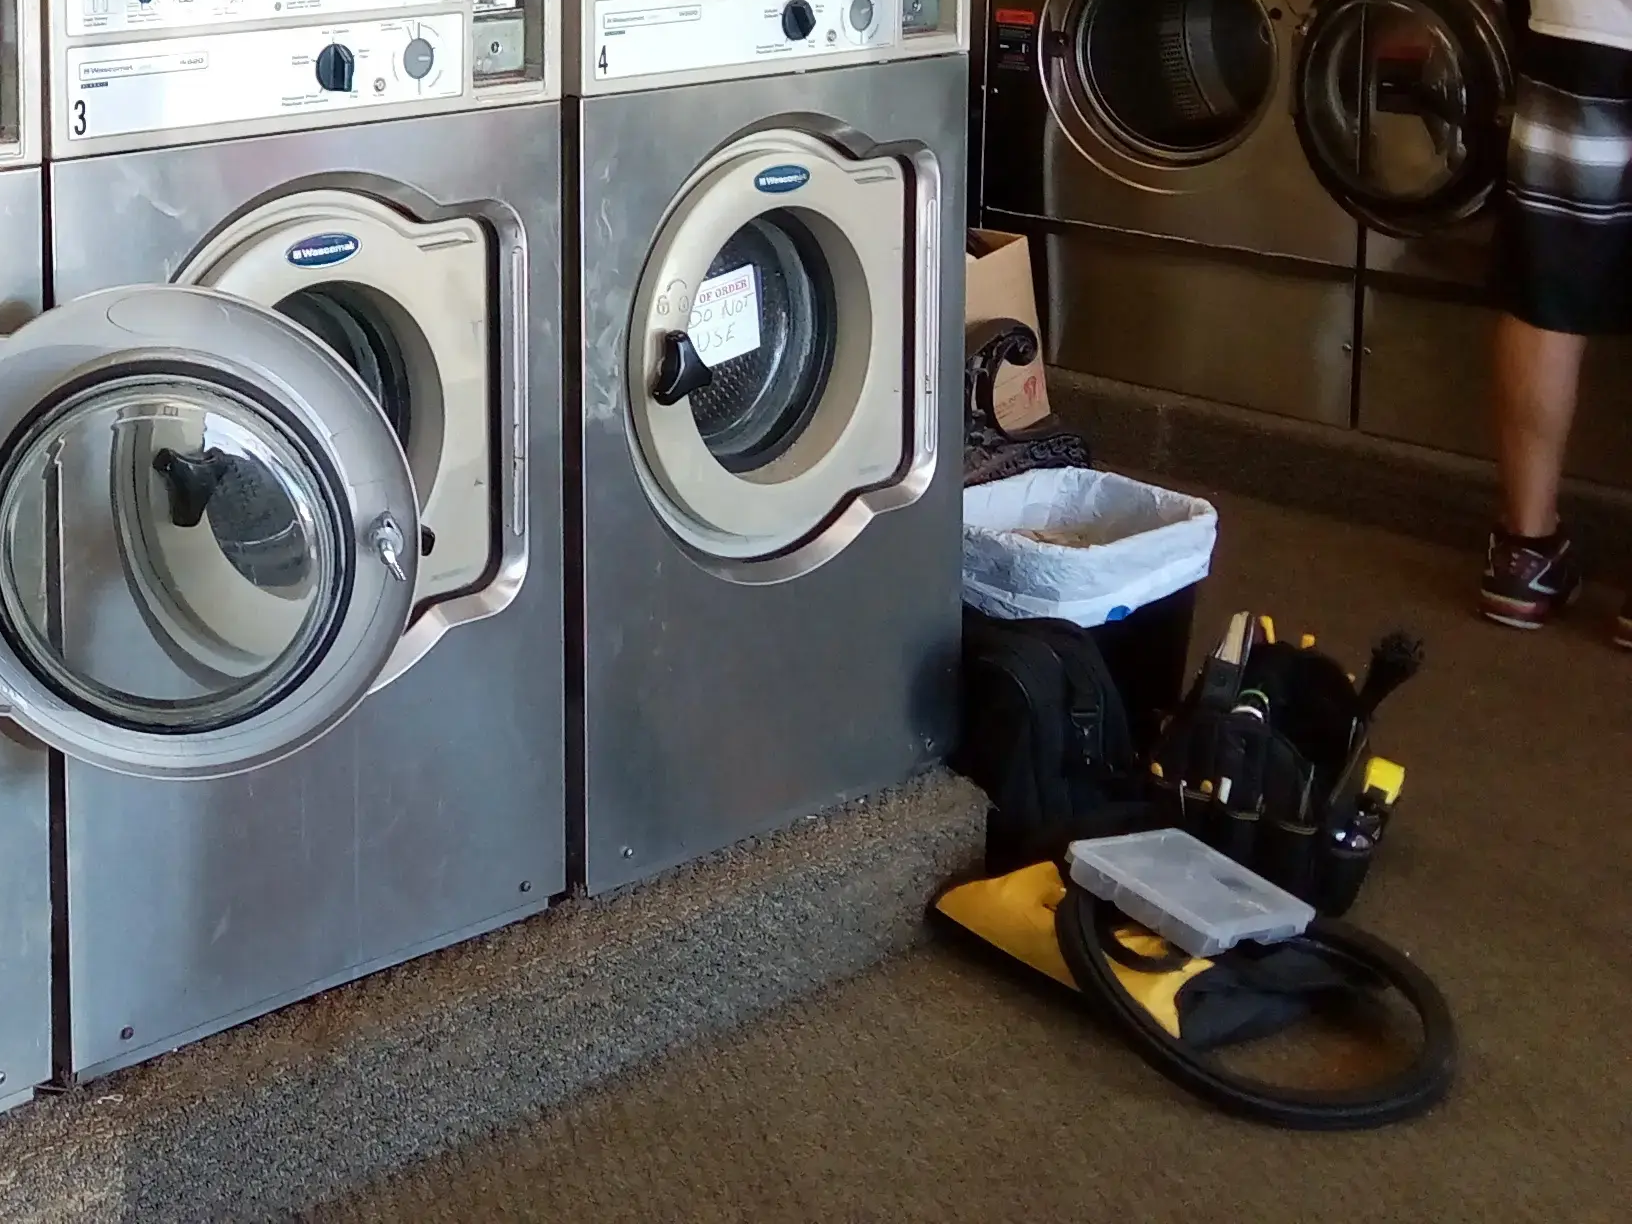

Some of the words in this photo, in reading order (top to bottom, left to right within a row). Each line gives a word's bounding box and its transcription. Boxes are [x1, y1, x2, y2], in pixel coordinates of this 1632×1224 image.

[598, 45, 608, 75] 4
[73, 99, 87, 136] 3
[301, 240, 355, 258] Wascomat
[699, 290, 713, 304] OF
[714, 279, 748, 299] ORDER
[721, 291, 755, 320] NOT
[696, 321, 736, 353] USE
